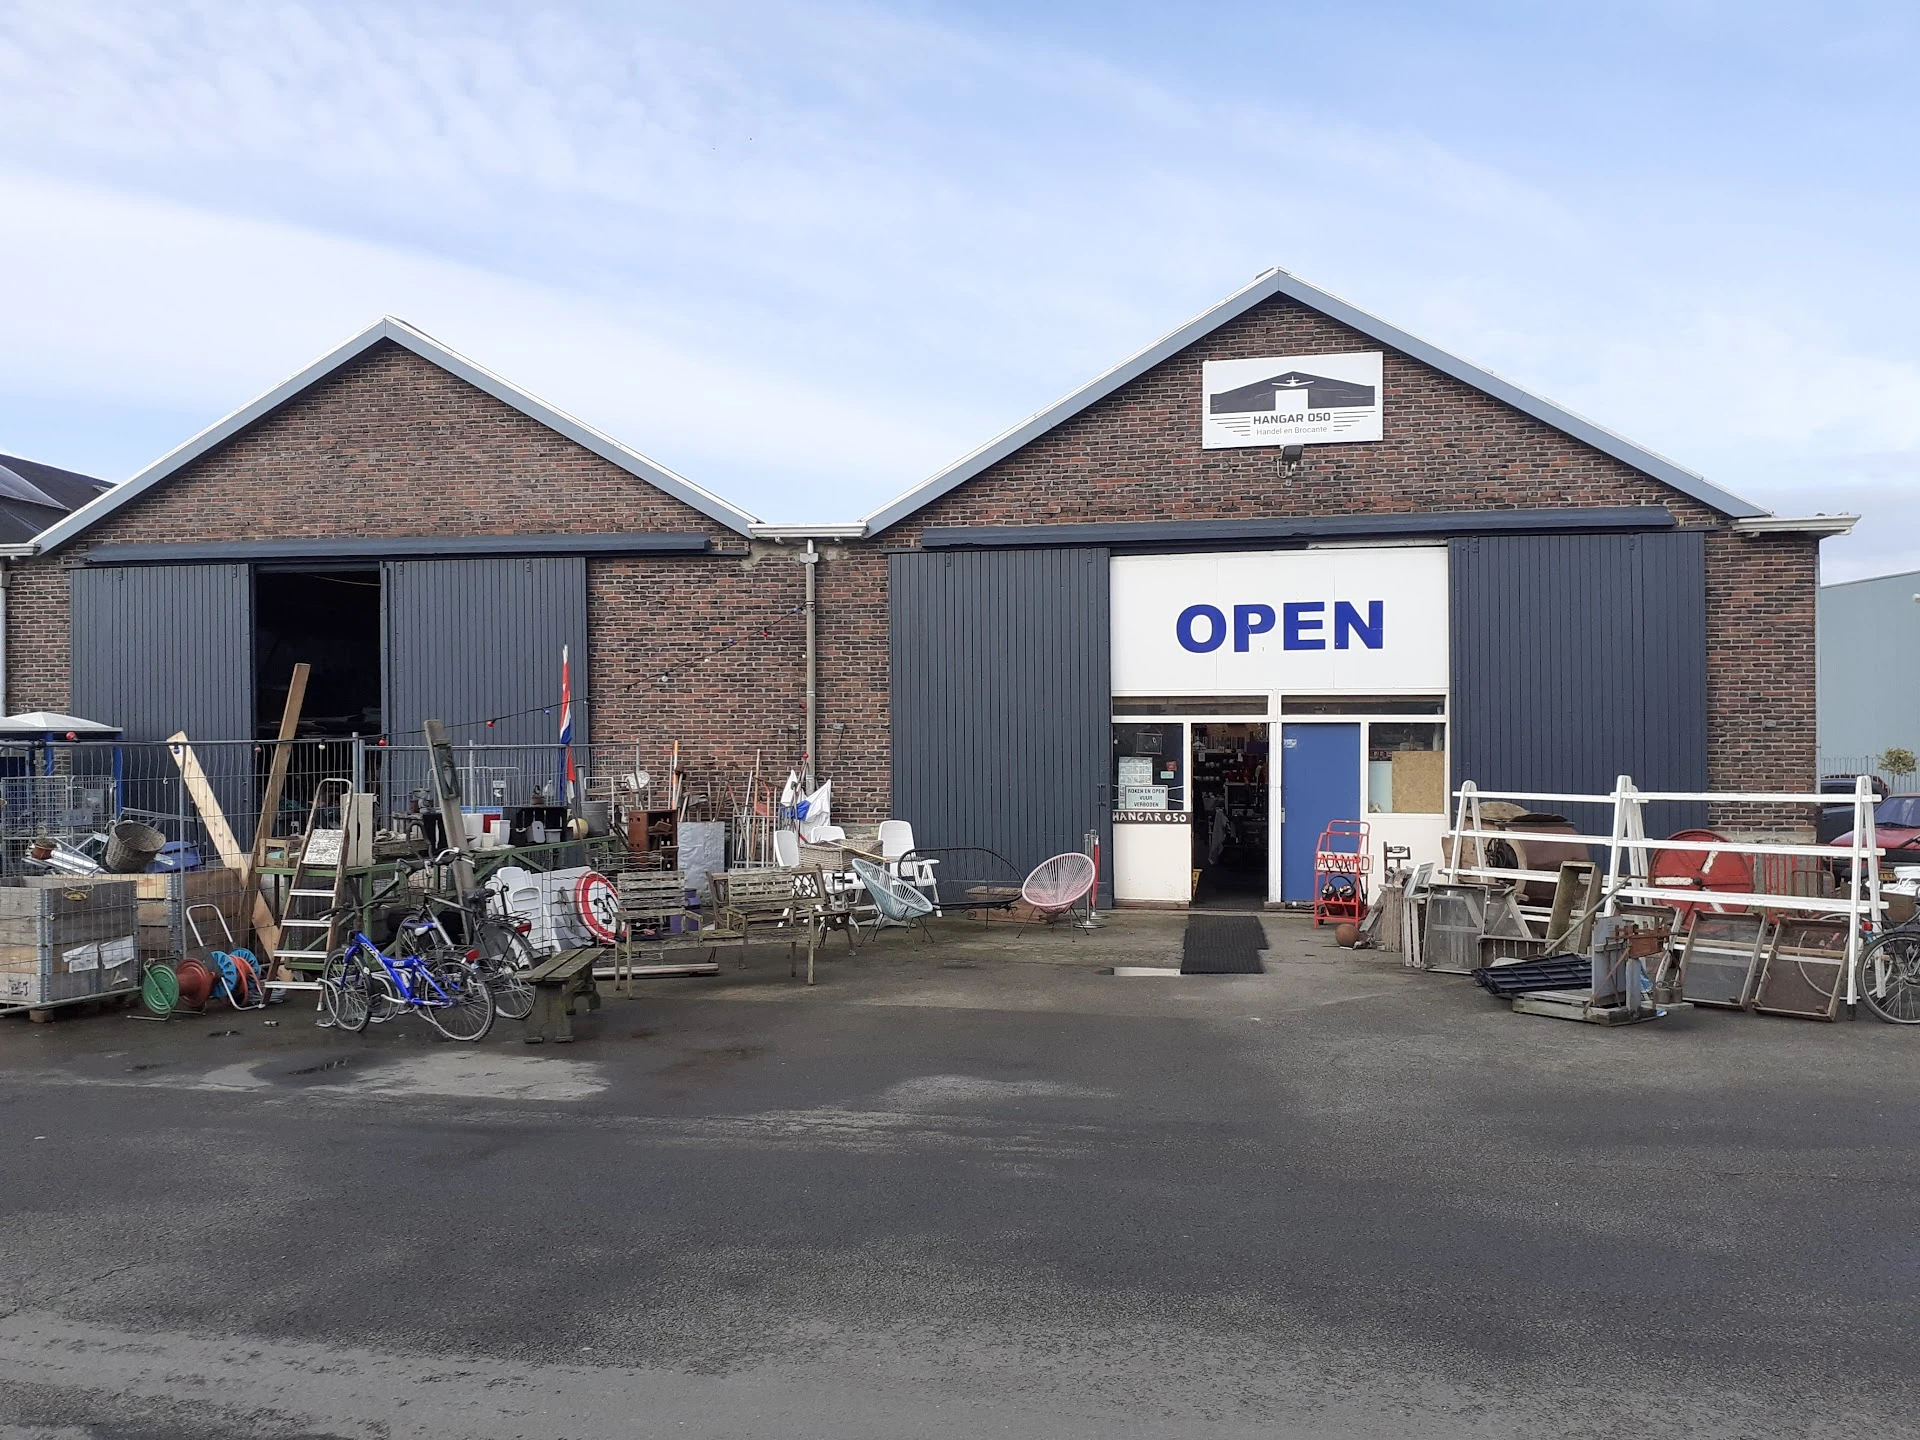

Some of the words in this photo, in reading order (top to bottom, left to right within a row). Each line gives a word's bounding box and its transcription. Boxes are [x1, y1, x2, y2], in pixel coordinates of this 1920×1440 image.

[1253, 413, 1304, 425] HANGAR
[1307, 412, 1331, 422] 050
[1256, 427, 1282, 436] Handel
[1294, 426, 1328, 434] Brocante
[1176, 600, 1384, 653] OPEN
[1112, 812, 1162, 822] HANGAR
[1164, 812, 1187, 823] 050
